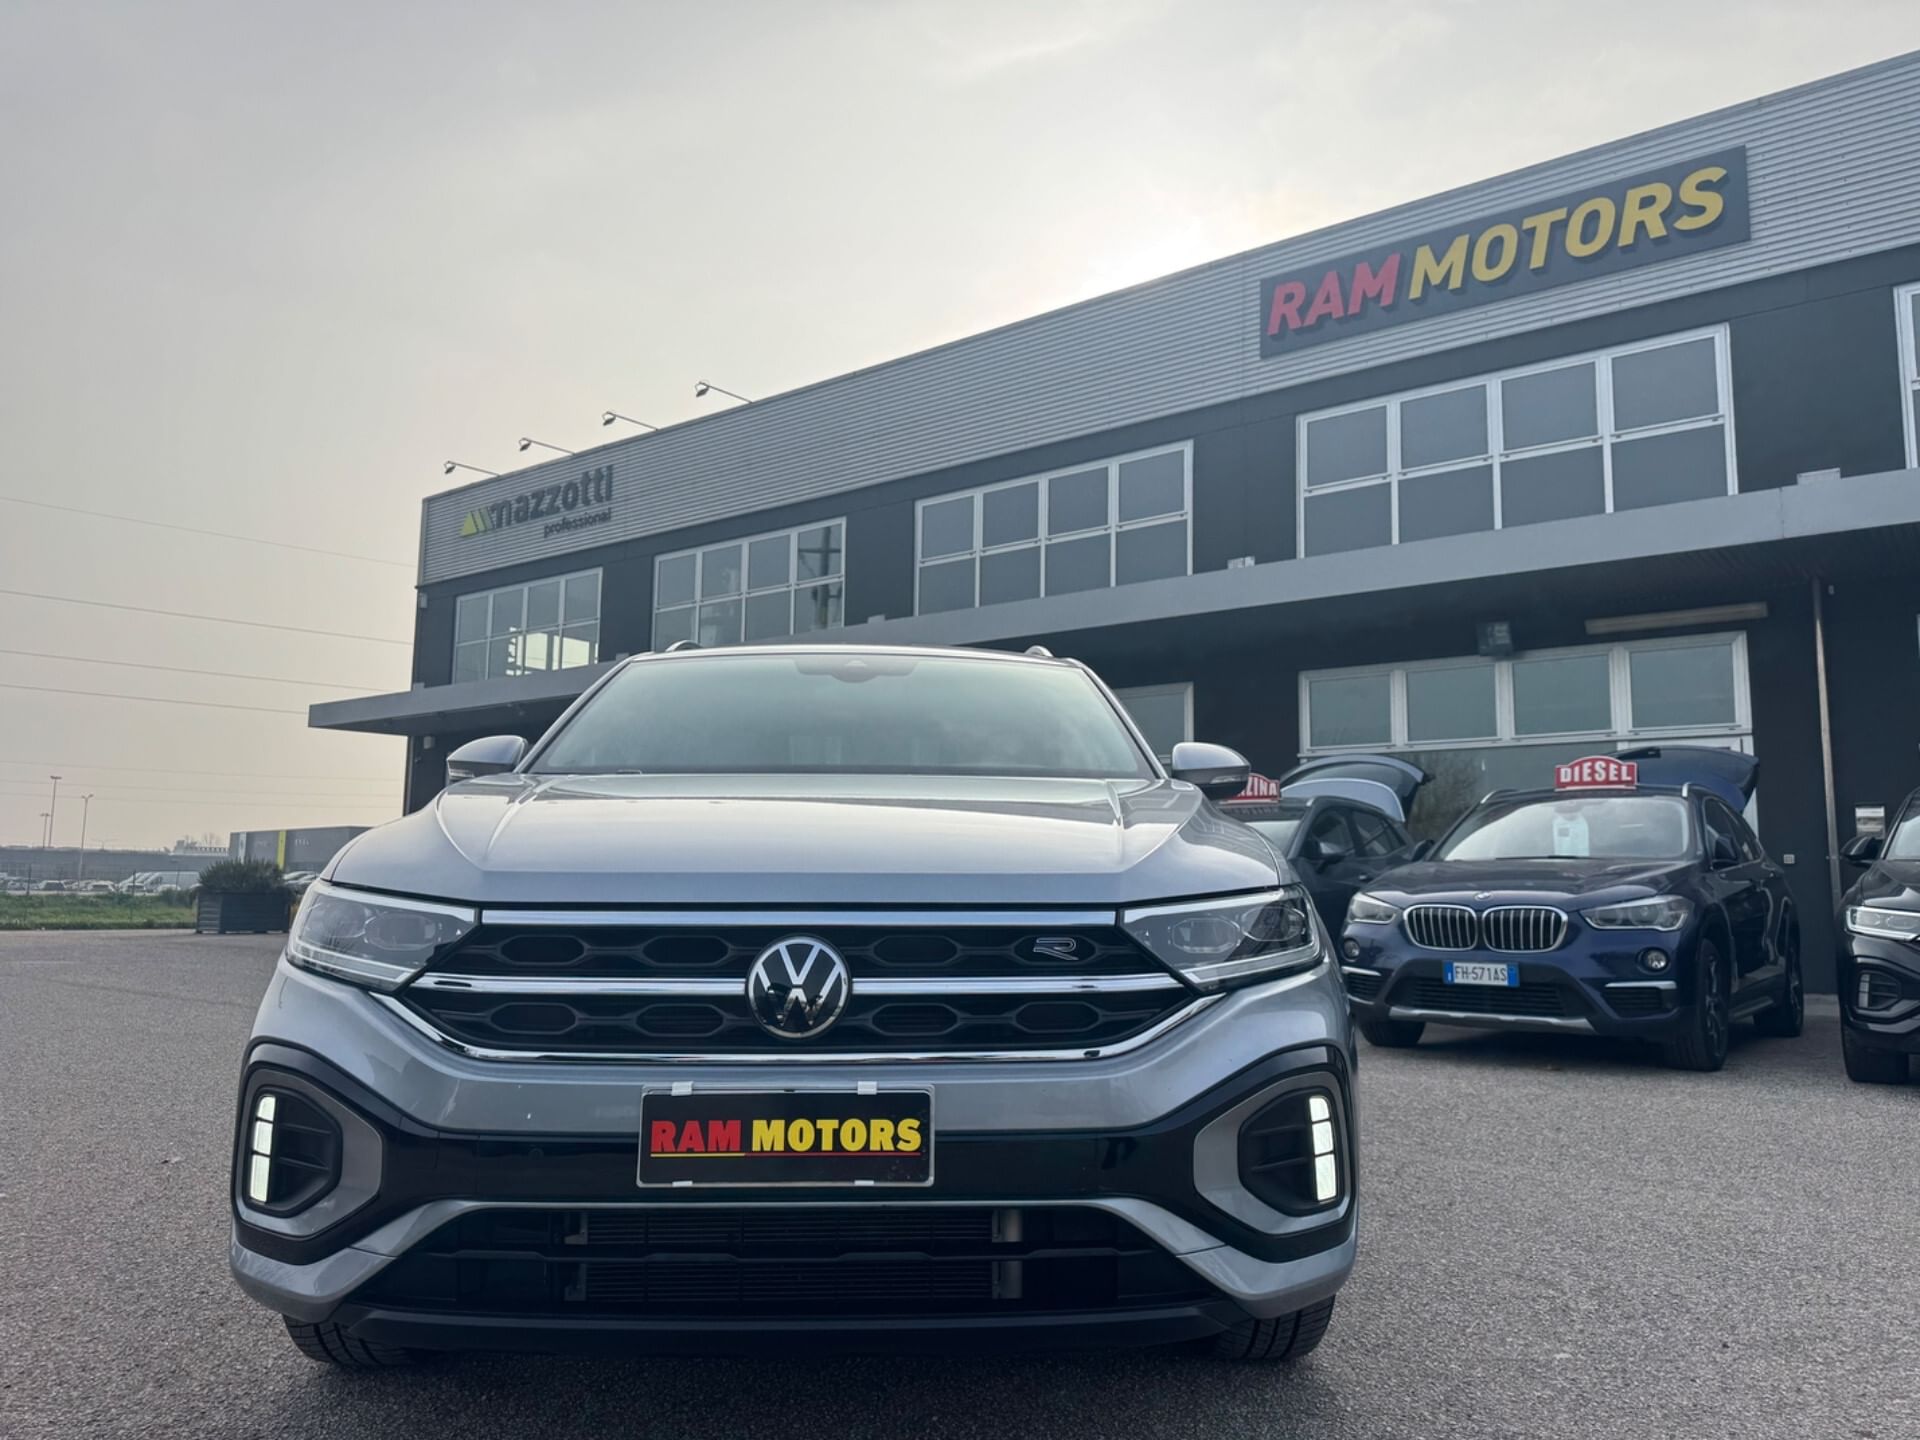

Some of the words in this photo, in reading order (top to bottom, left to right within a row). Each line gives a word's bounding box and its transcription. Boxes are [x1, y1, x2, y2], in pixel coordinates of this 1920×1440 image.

[1266, 253, 1400, 336] RAM
[1408, 166, 1728, 300] MOTORS
[543, 507, 612, 539] professional
[1560, 760, 1632, 783] DIESEL
[650, 1119, 742, 1152] RAM
[751, 1118, 922, 1152] MOTORS
